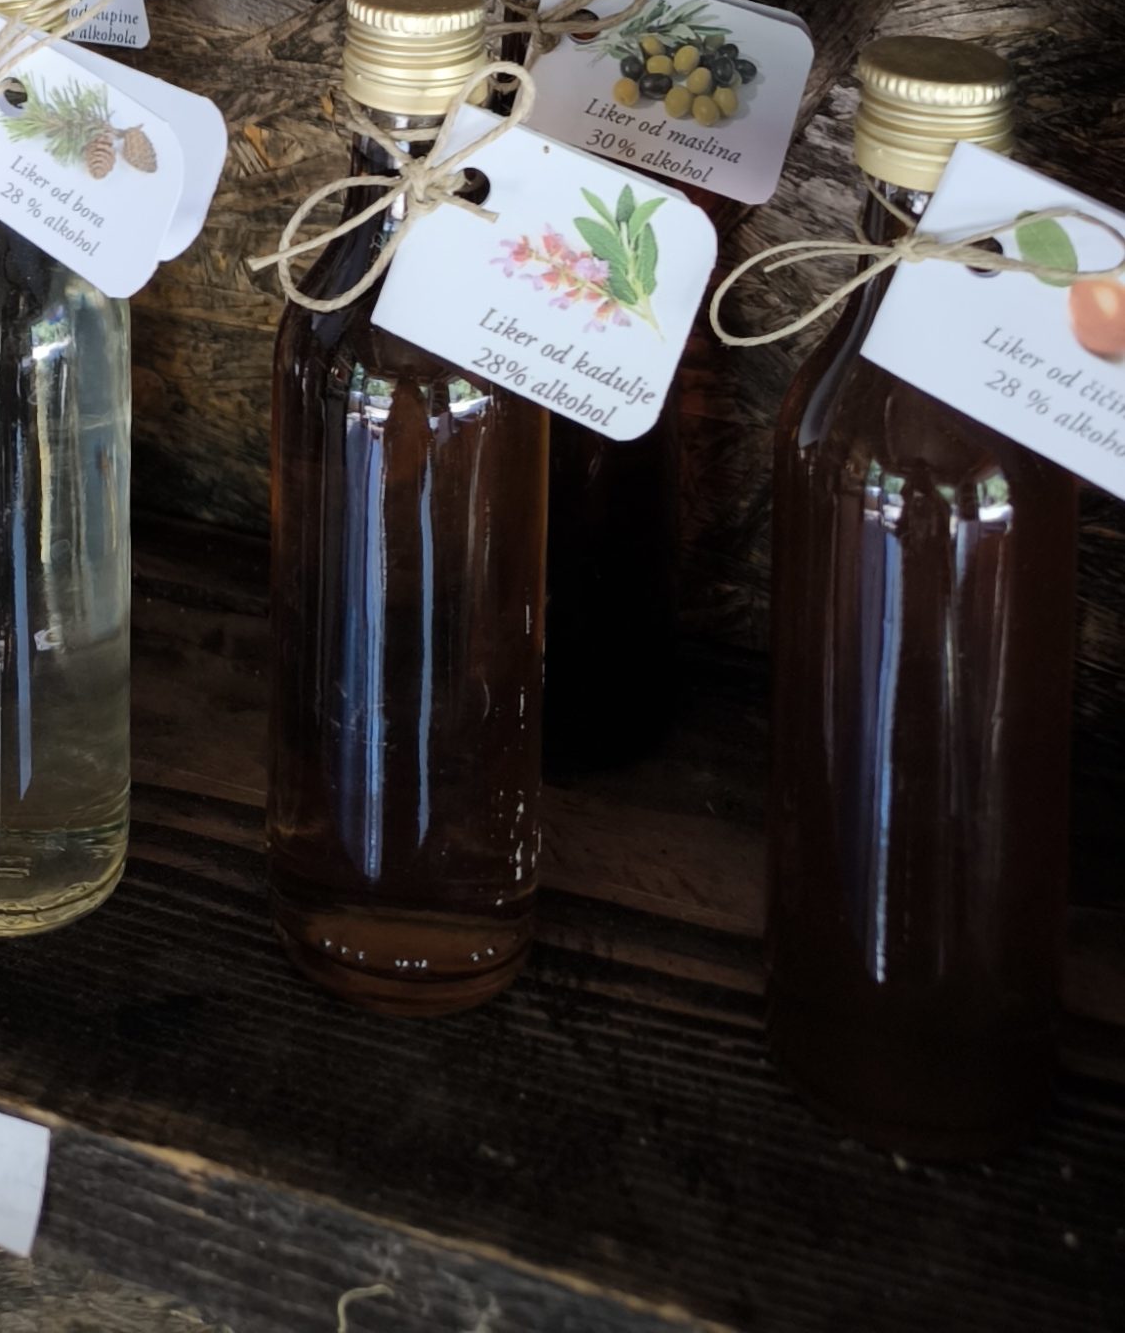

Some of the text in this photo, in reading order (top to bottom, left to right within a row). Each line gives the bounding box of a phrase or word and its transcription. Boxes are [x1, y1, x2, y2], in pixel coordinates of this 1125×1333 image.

[80, 25, 136, 44] alkohola
[93, 10, 139, 25] upine
[584, 98, 742, 164] Liker od maslina
[641, 150, 714, 183] alkohol
[10, 155, 105, 228] Liker od bora
[43, 216, 101, 256] alkohol
[479, 308, 657, 405] Liker od kadulje
[982, 327, 1045, 368] Liker
[1046, 367, 1083, 388] od
[531, 379, 618, 426] alkohol
